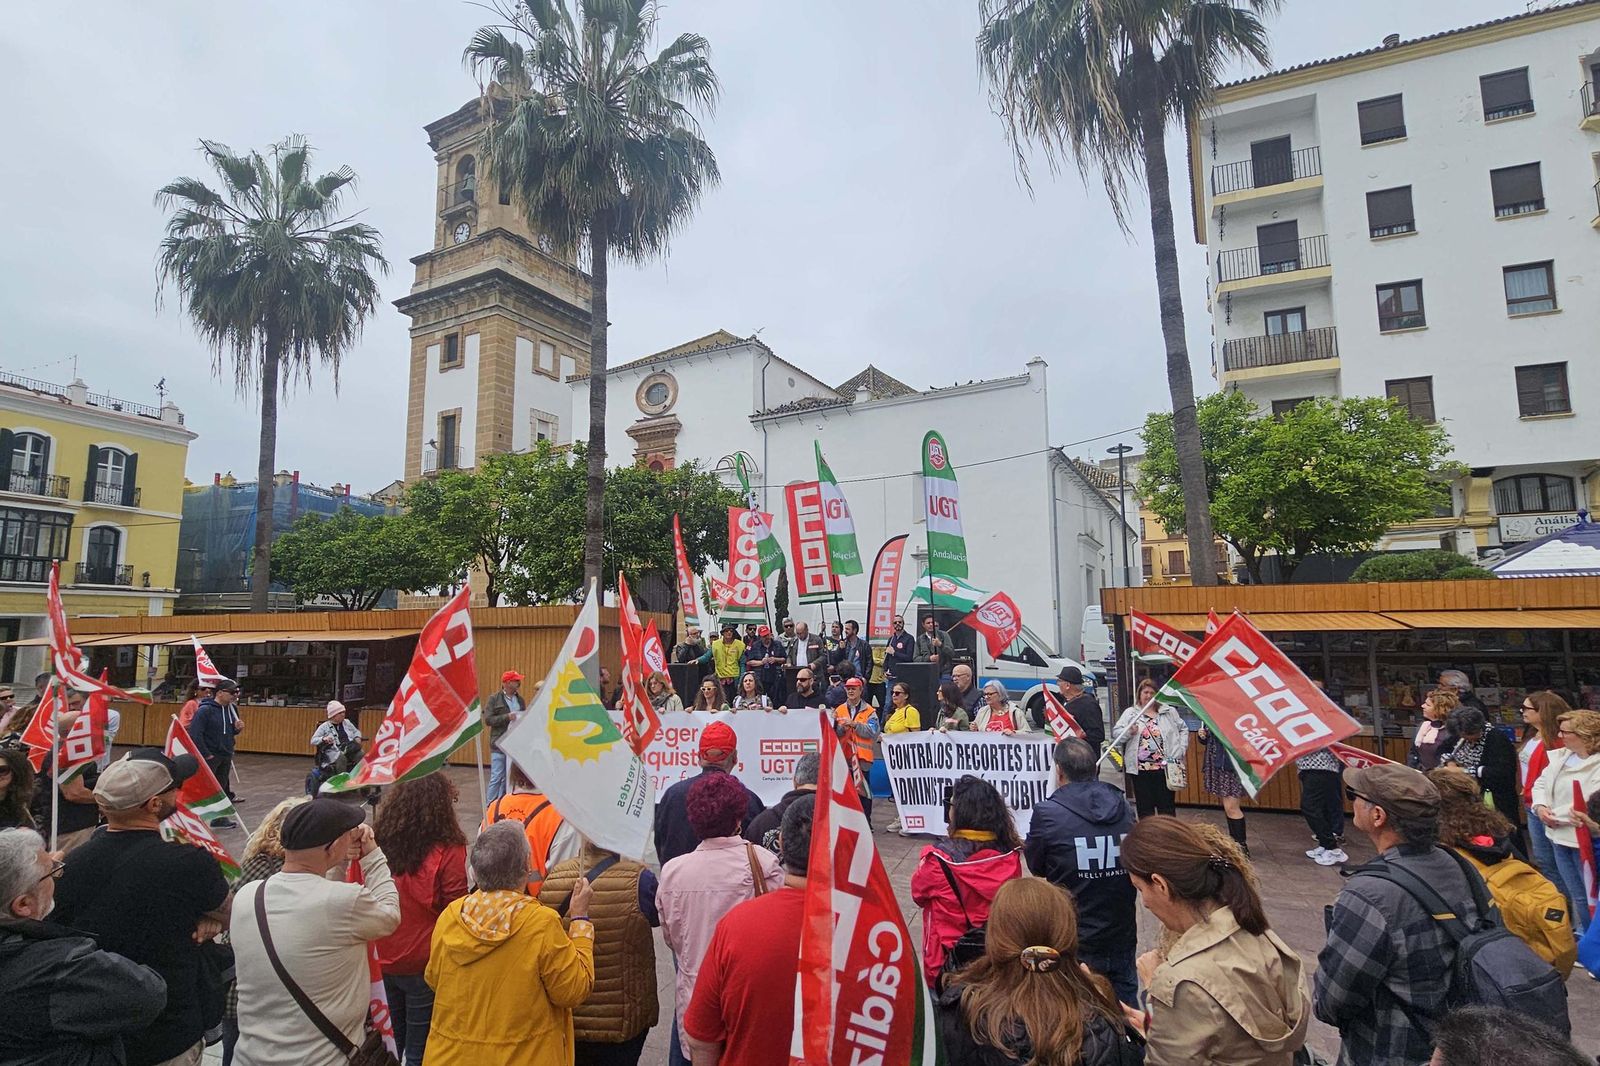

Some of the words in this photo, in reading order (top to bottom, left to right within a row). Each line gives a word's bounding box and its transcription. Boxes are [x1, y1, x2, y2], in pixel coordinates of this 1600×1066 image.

[929, 496, 957, 520] UGT
[794, 487, 831, 593] CCOO
[873, 551, 898, 627] CCOO
[1131, 615, 1198, 663] CCOO
[1211, 635, 1334, 747] CCOO
[762, 742, 801, 753] CCOO
[888, 743, 935, 770] CONTRA
[956, 743, 1023, 772] RECORTES
[1026, 744, 1041, 772] EN
[1234, 713, 1284, 766] Cádiz
[760, 759, 795, 774] UGT
